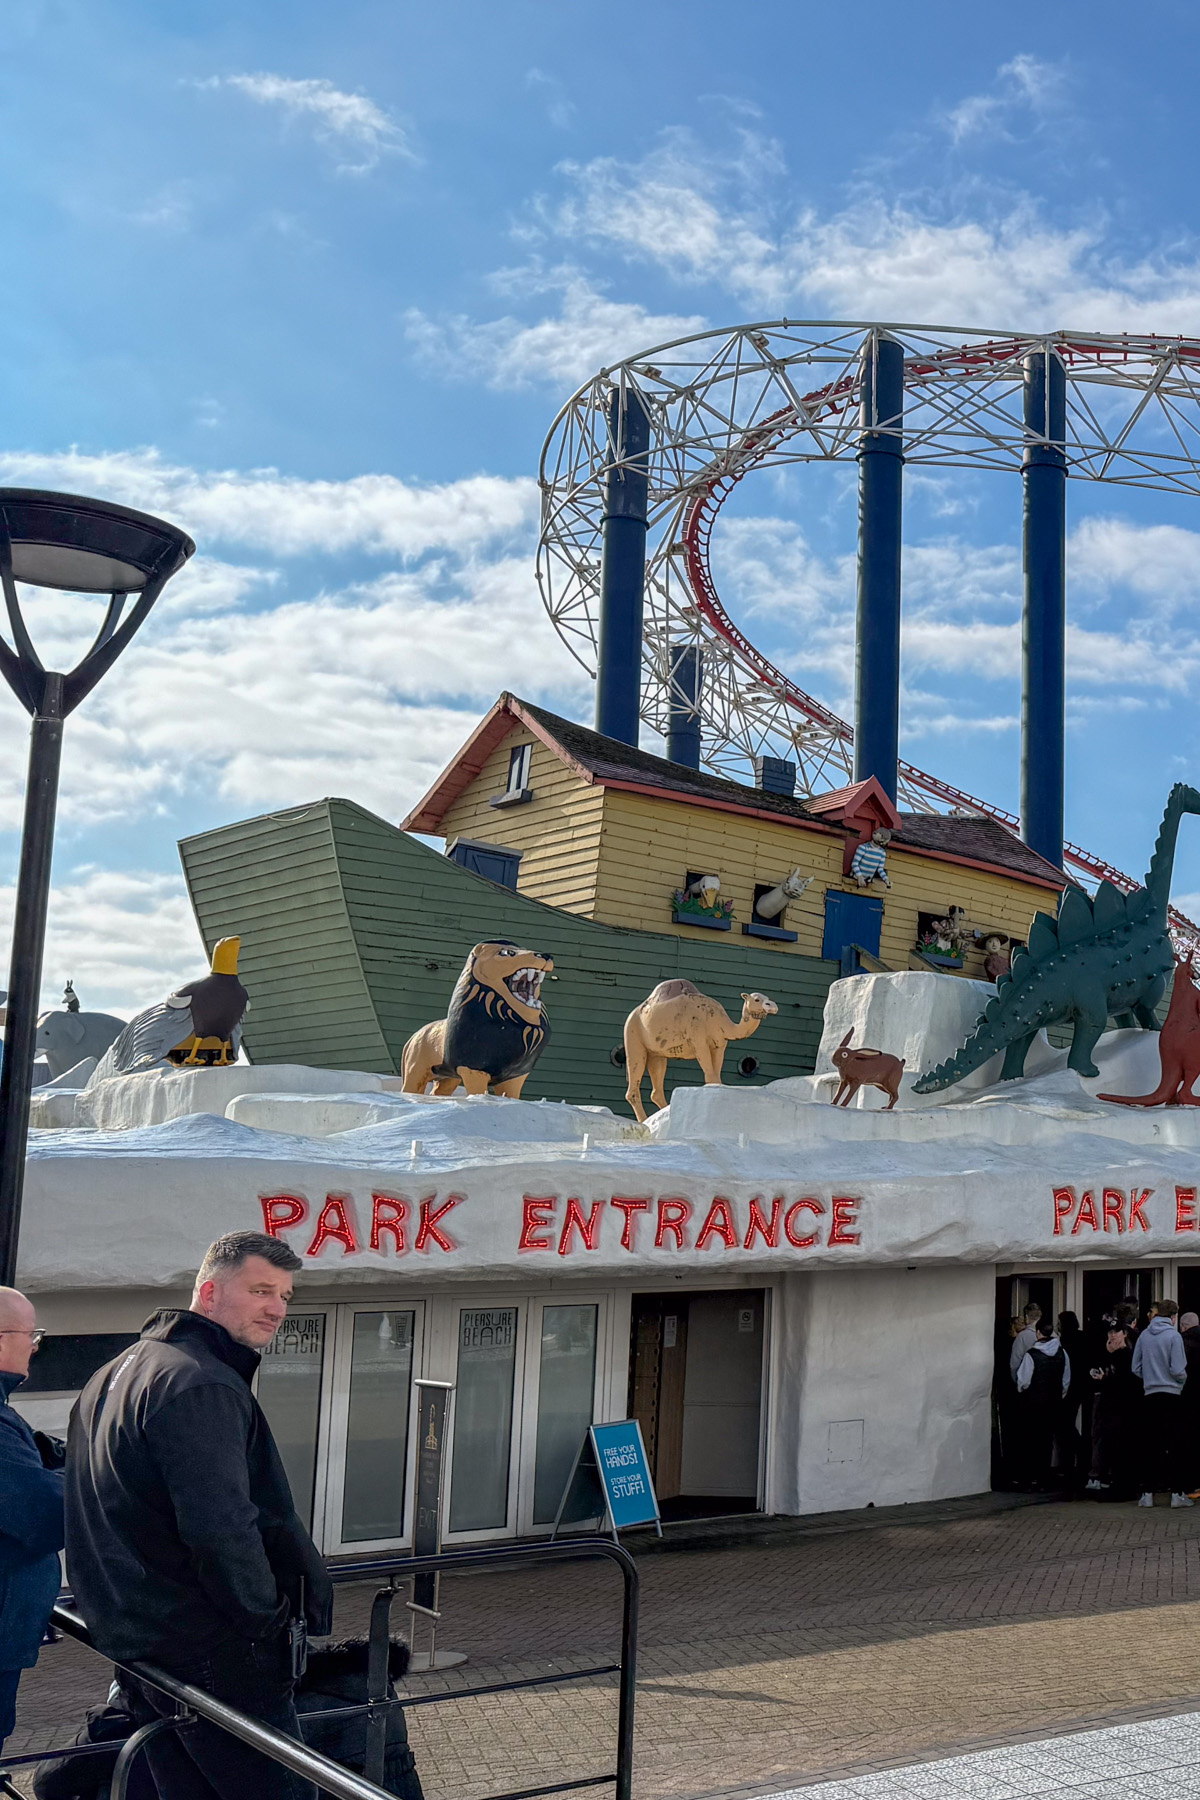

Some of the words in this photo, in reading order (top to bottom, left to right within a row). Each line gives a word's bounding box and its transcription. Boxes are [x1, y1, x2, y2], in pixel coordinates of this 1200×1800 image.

[1052, 1186, 1154, 1236] PARK
[258, 1193, 466, 1256] PARK
[517, 1194, 862, 1256] ENTRANCE
[464, 1312, 512, 1327] PLEASURE
[463, 1326, 512, 1346] BEACH
[603, 1446, 618, 1457] FREE
[618, 1444, 636, 1454] YOUR
[605, 1452, 638, 1468] HANDS!
[610, 1475, 627, 1485] STORE
[627, 1473, 642, 1482] YOUR
[612, 1480, 645, 1498] STUFF!
